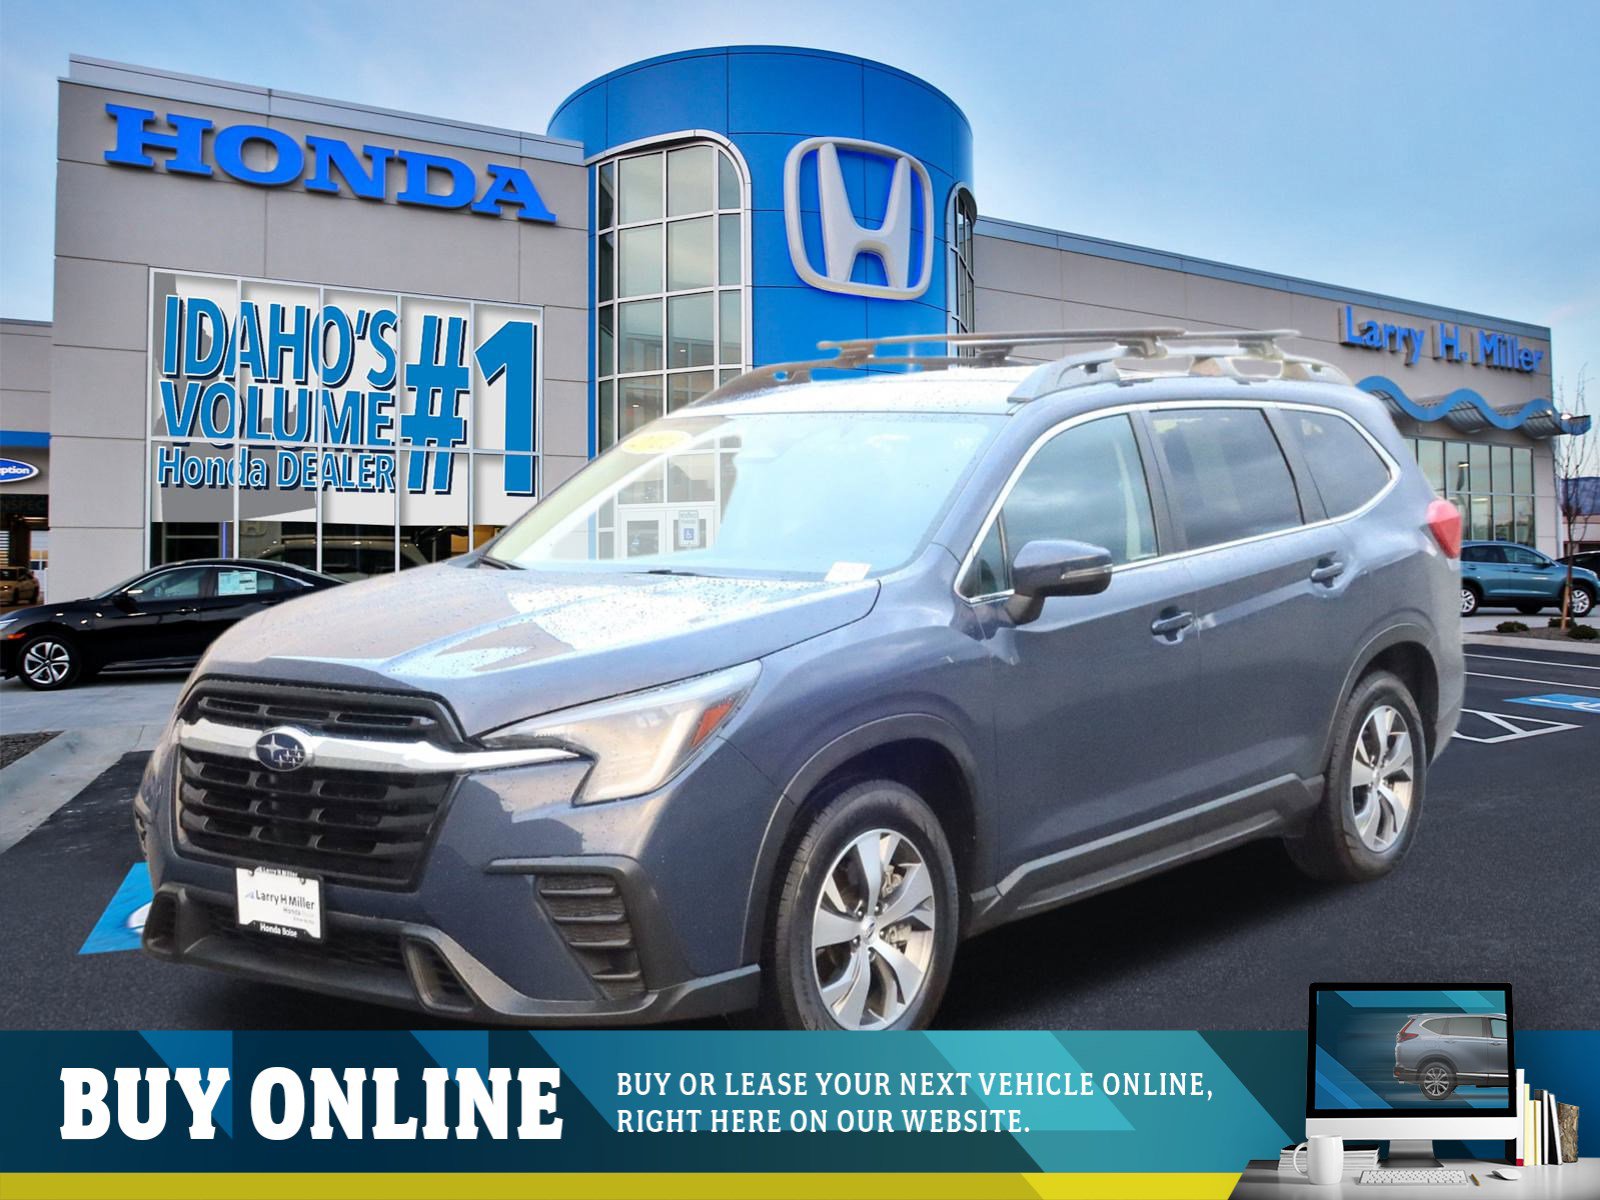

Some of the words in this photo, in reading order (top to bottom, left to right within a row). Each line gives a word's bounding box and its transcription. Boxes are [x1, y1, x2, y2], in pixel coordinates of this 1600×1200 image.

[104, 103, 557, 223] HONDA
[162, 294, 400, 390] IDAHO'S
[1342, 305, 1425, 366] Larry
[1433, 322, 1470, 362] H.
[1472, 329, 1545, 374] Miller
[159, 380, 397, 450] VOLUME
[0, 465, 30, 476] ption
[156, 446, 271, 490] Honda
[276, 449, 397, 494] DEALER
[256, 890, 279, 905] Larry
[281, 894, 287, 904] H
[289, 896, 314, 910] Miller
[260, 923, 281, 934] Honda
